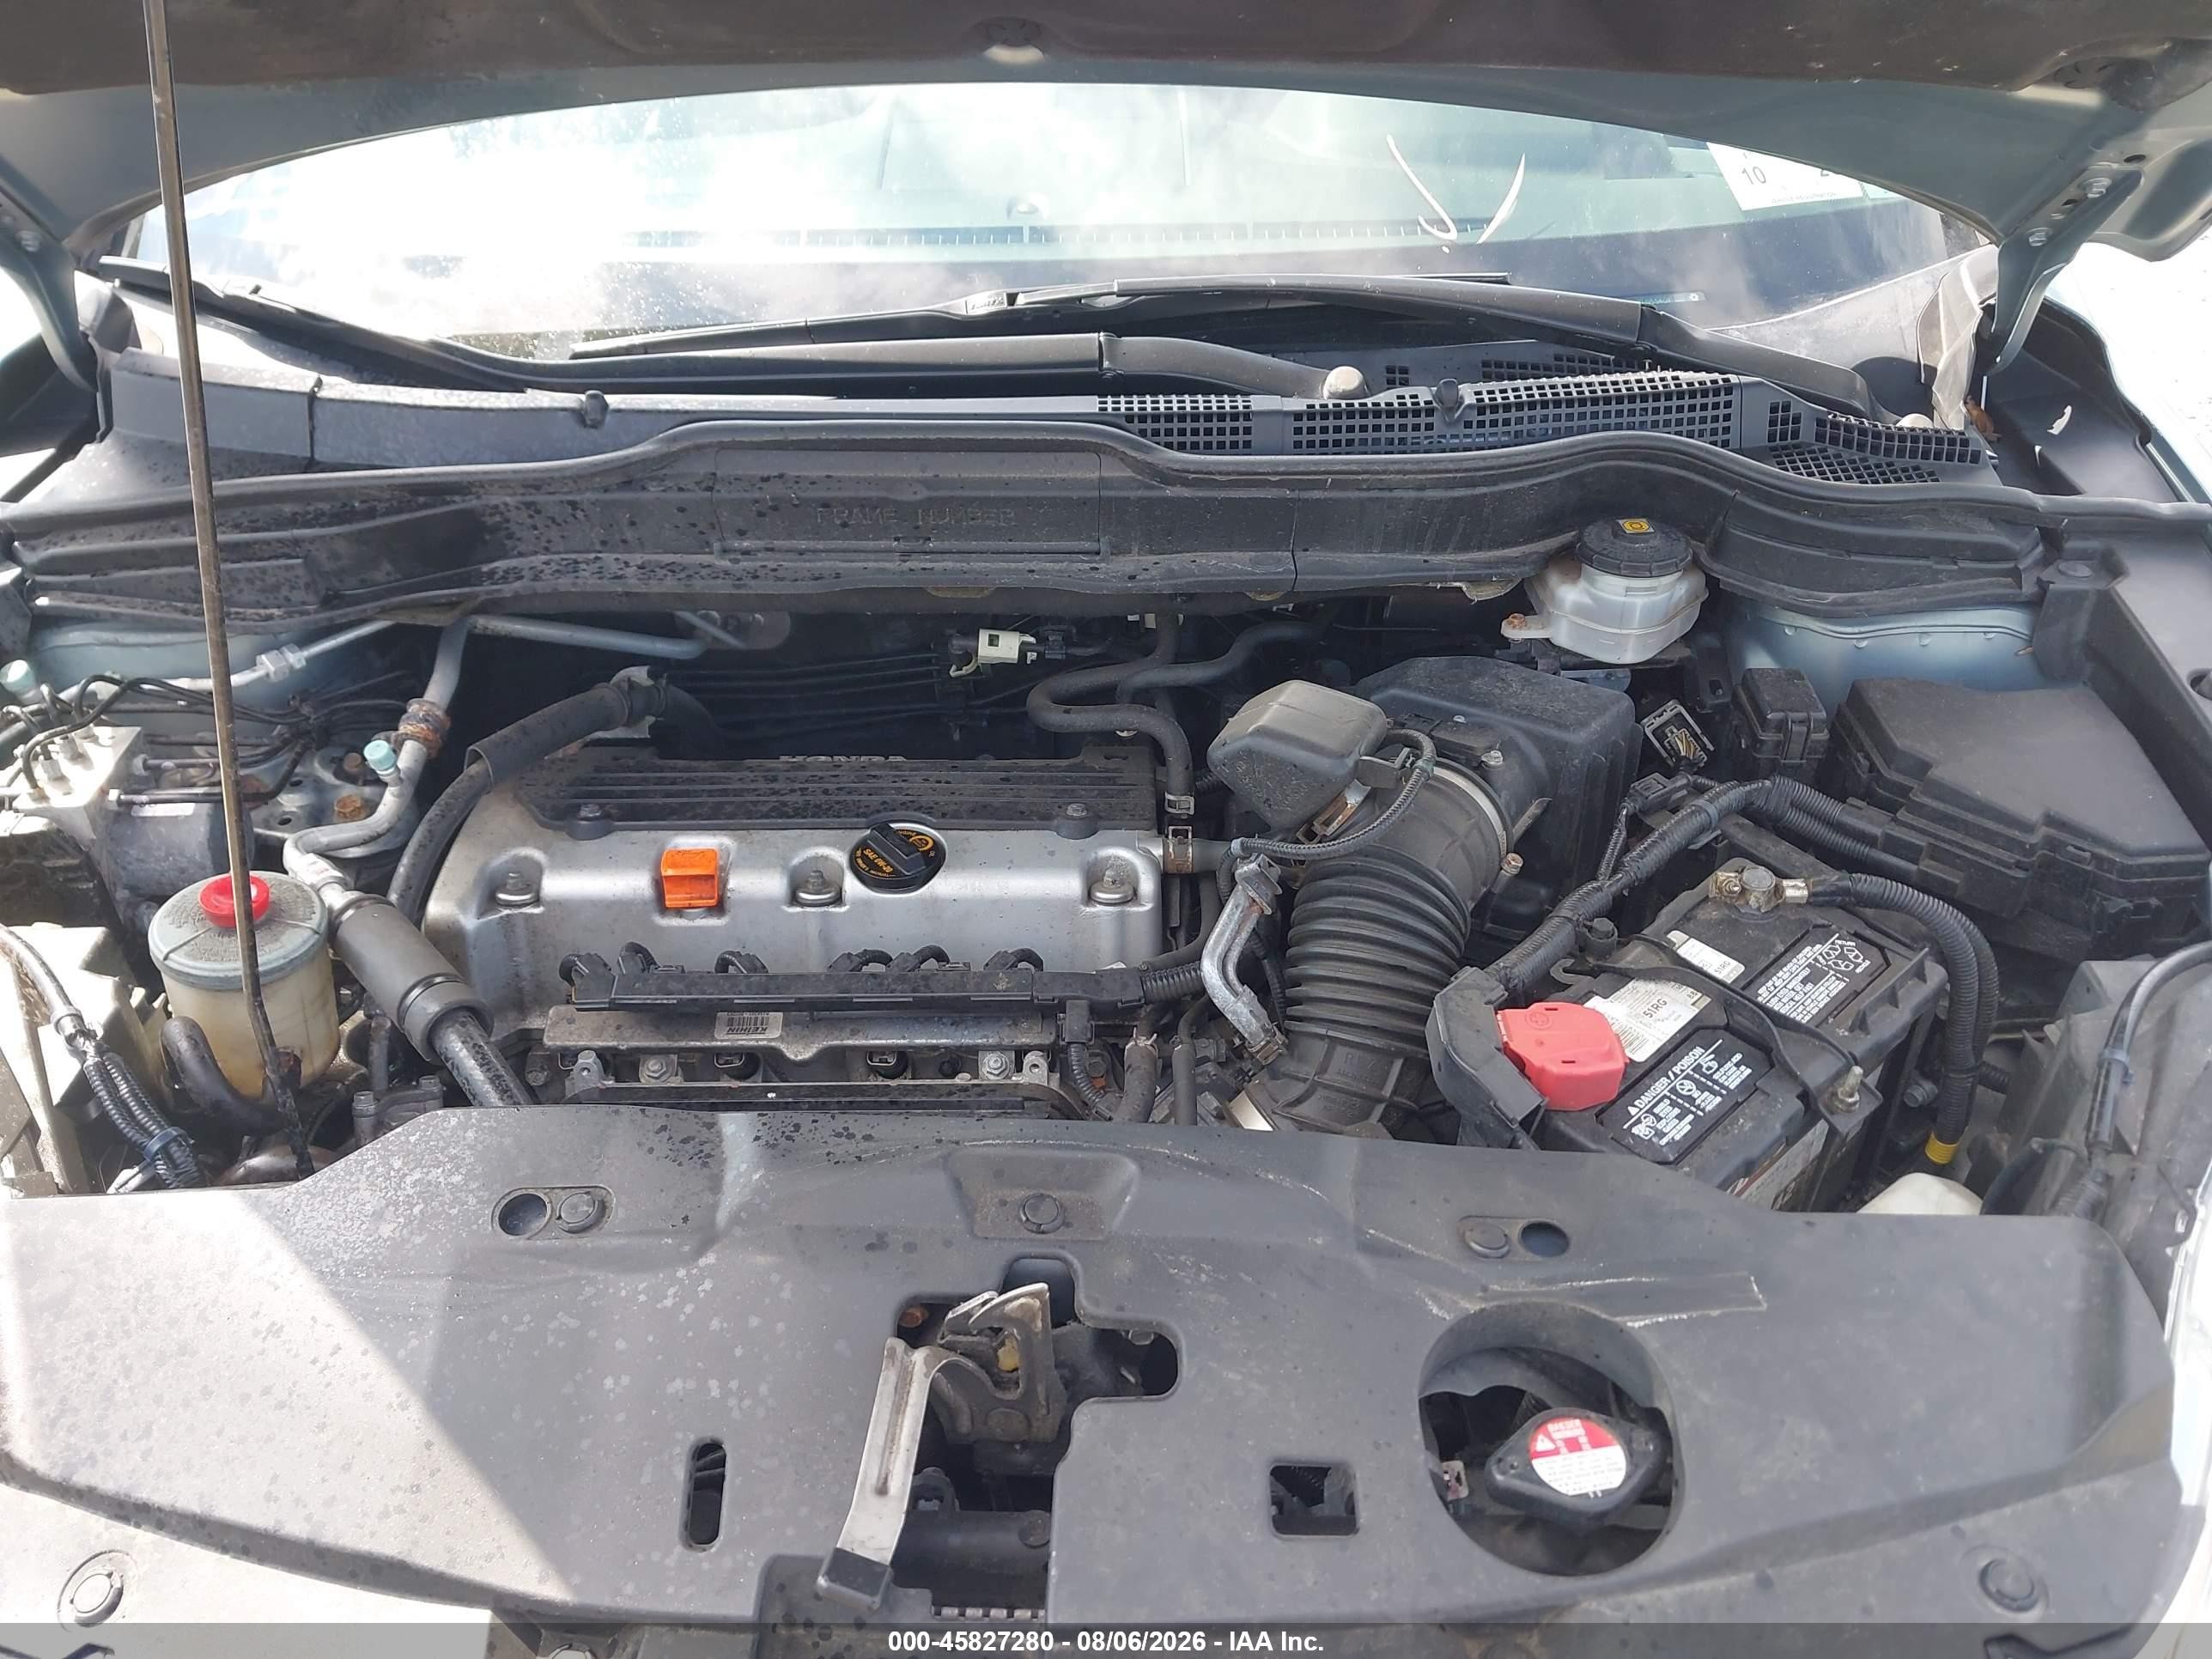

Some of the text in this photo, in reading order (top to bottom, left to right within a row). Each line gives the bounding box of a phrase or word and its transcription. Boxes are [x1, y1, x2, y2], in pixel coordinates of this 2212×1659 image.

[1741, 165, 1767, 185] 10
[862, 848, 878, 860] SAE
[1643, 997, 1668, 1018] 51RG
[1633, 1076, 1671, 1108] DANGER
[1671, 1046, 1705, 1073] POISON
